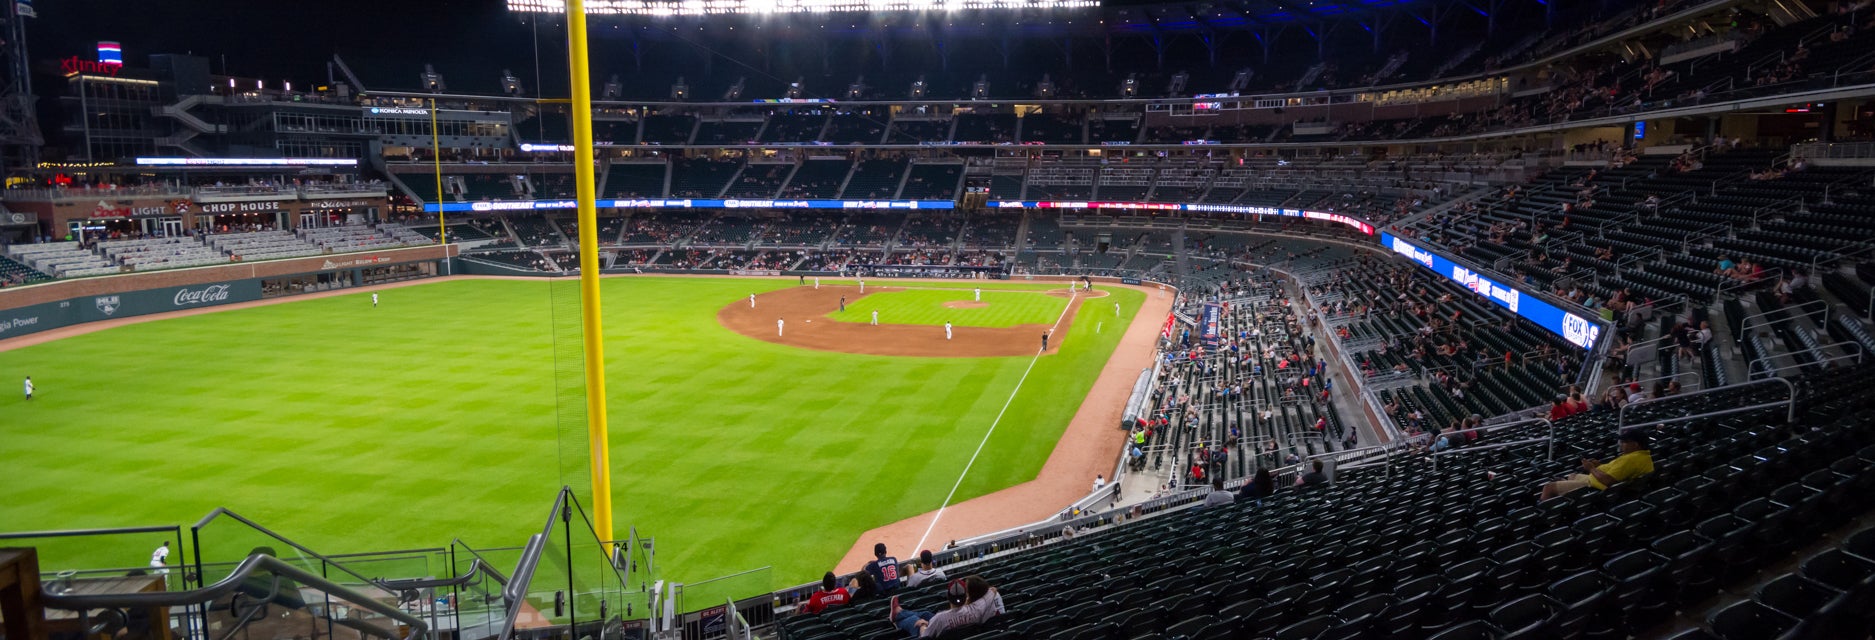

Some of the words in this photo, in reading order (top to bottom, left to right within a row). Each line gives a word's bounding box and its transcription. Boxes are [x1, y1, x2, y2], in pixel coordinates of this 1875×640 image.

[60, 56, 122, 77] xfinity
[132, 206, 165, 216] LIGHT
[202, 203, 235, 212] CHOP
[240, 202, 279, 211] HOUSE
[493, 202, 534, 210] SOUTHEAST
[174, 284, 231, 305] Coca-Cola
[13, 317, 38, 328] Power
[1569, 316, 1583, 337] FOX
[881, 565, 898, 582] 16
[820, 594, 844, 604] FREEMAN
